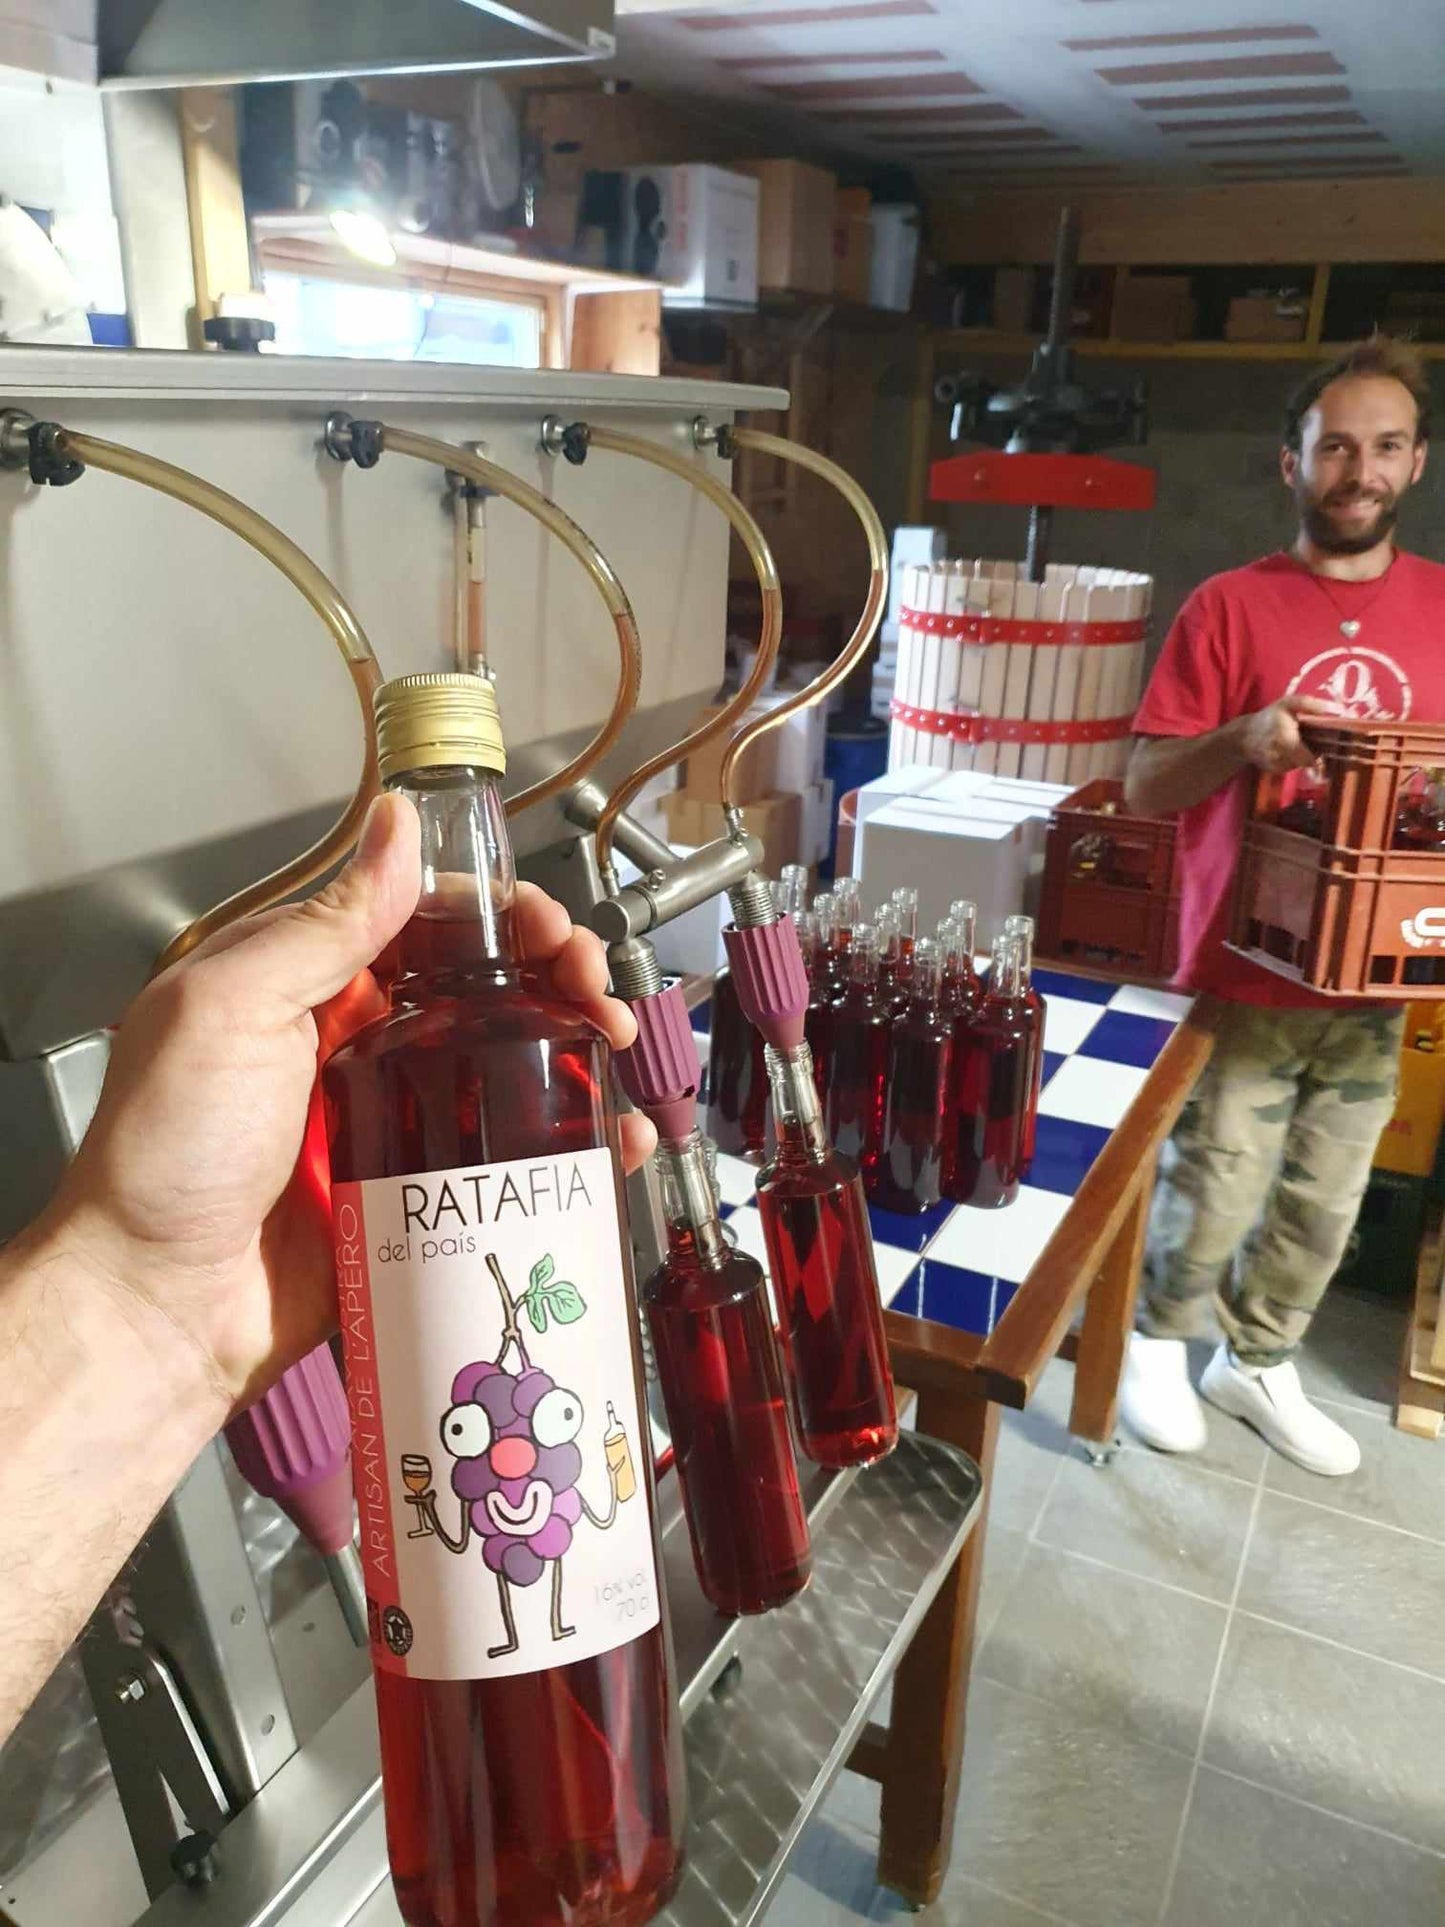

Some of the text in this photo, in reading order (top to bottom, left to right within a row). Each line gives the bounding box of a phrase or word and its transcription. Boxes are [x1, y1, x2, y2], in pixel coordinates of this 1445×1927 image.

[402, 1162, 592, 1233] RATAFIA
[378, 1232, 477, 1264] del país
[356, 1376, 376, 1418] DE
[361, 1433, 391, 1577] ARTISAN
